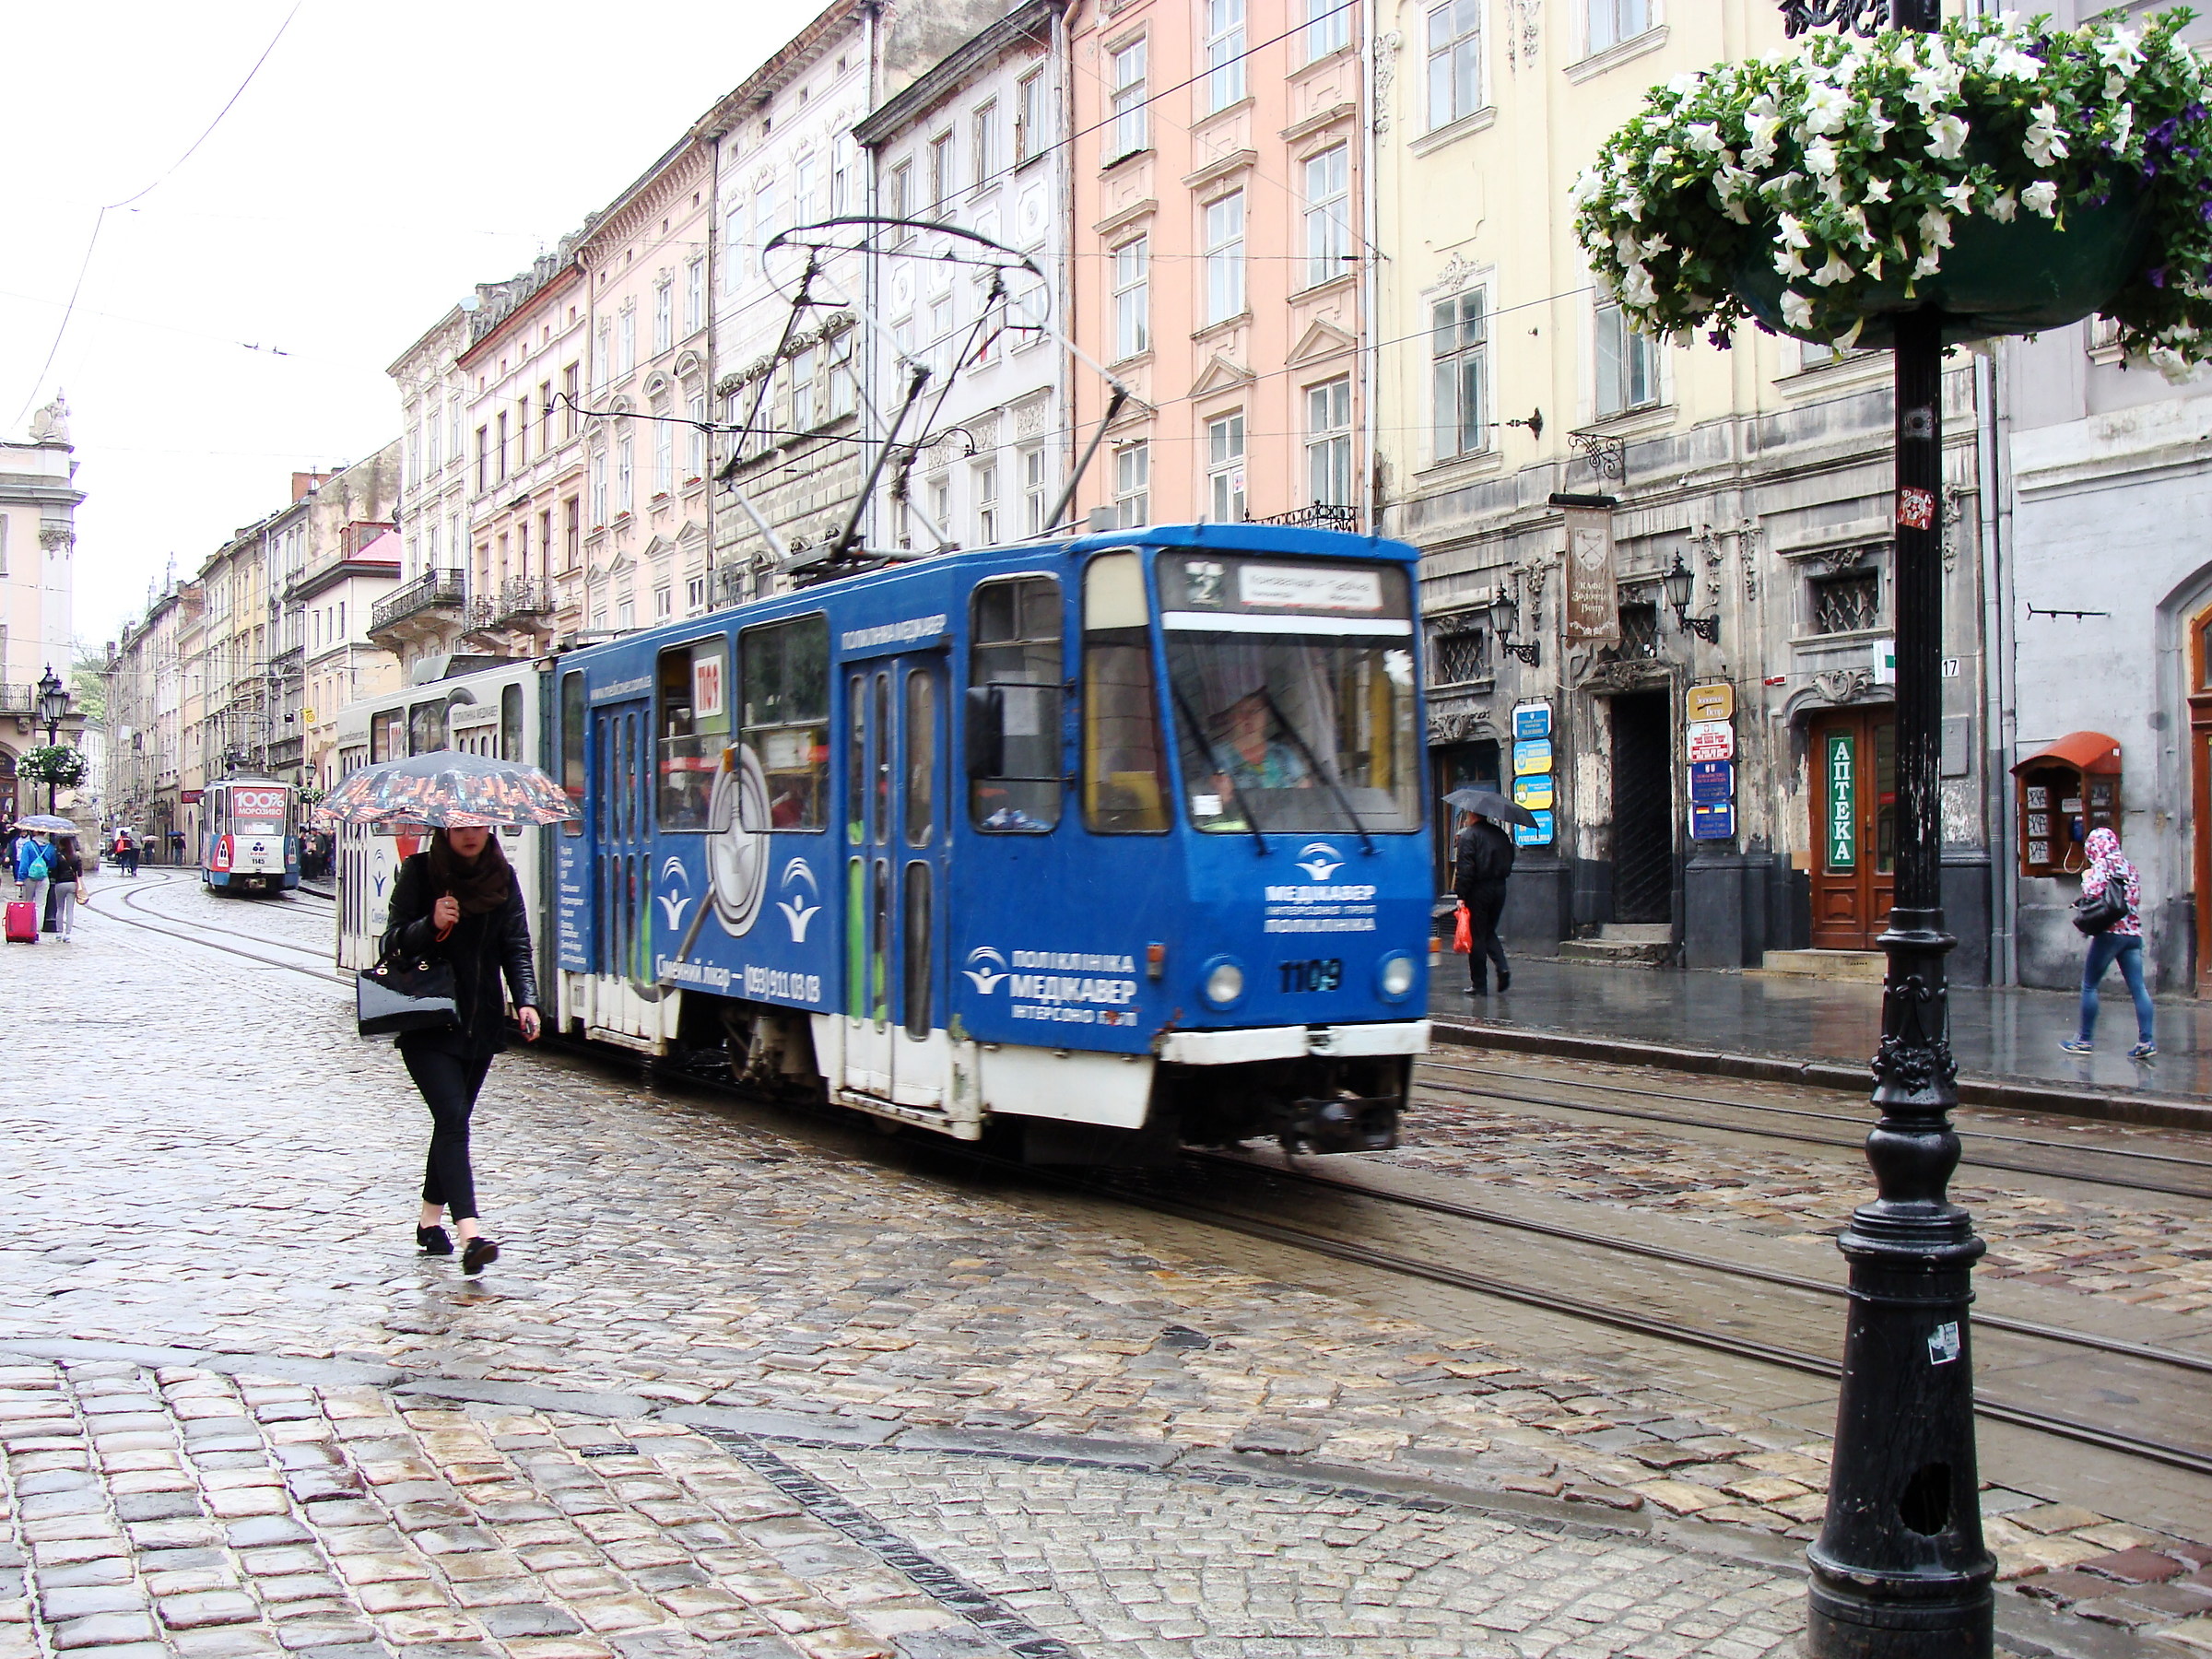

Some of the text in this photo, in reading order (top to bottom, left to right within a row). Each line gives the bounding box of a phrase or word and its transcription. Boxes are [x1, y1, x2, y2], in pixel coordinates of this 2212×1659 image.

[1943, 660, 1958, 677] 17
[234, 791, 285, 808] 100%
[1834, 741, 1852, 861] АПТЕКА
[238, 807, 282, 816] МОРОЗИВО
[1012, 950, 1136, 973] ПОЛІКЛІНІКА
[1278, 958, 1342, 994] 1109
[1009, 974, 1138, 1006] МЕДІКАВЕР
